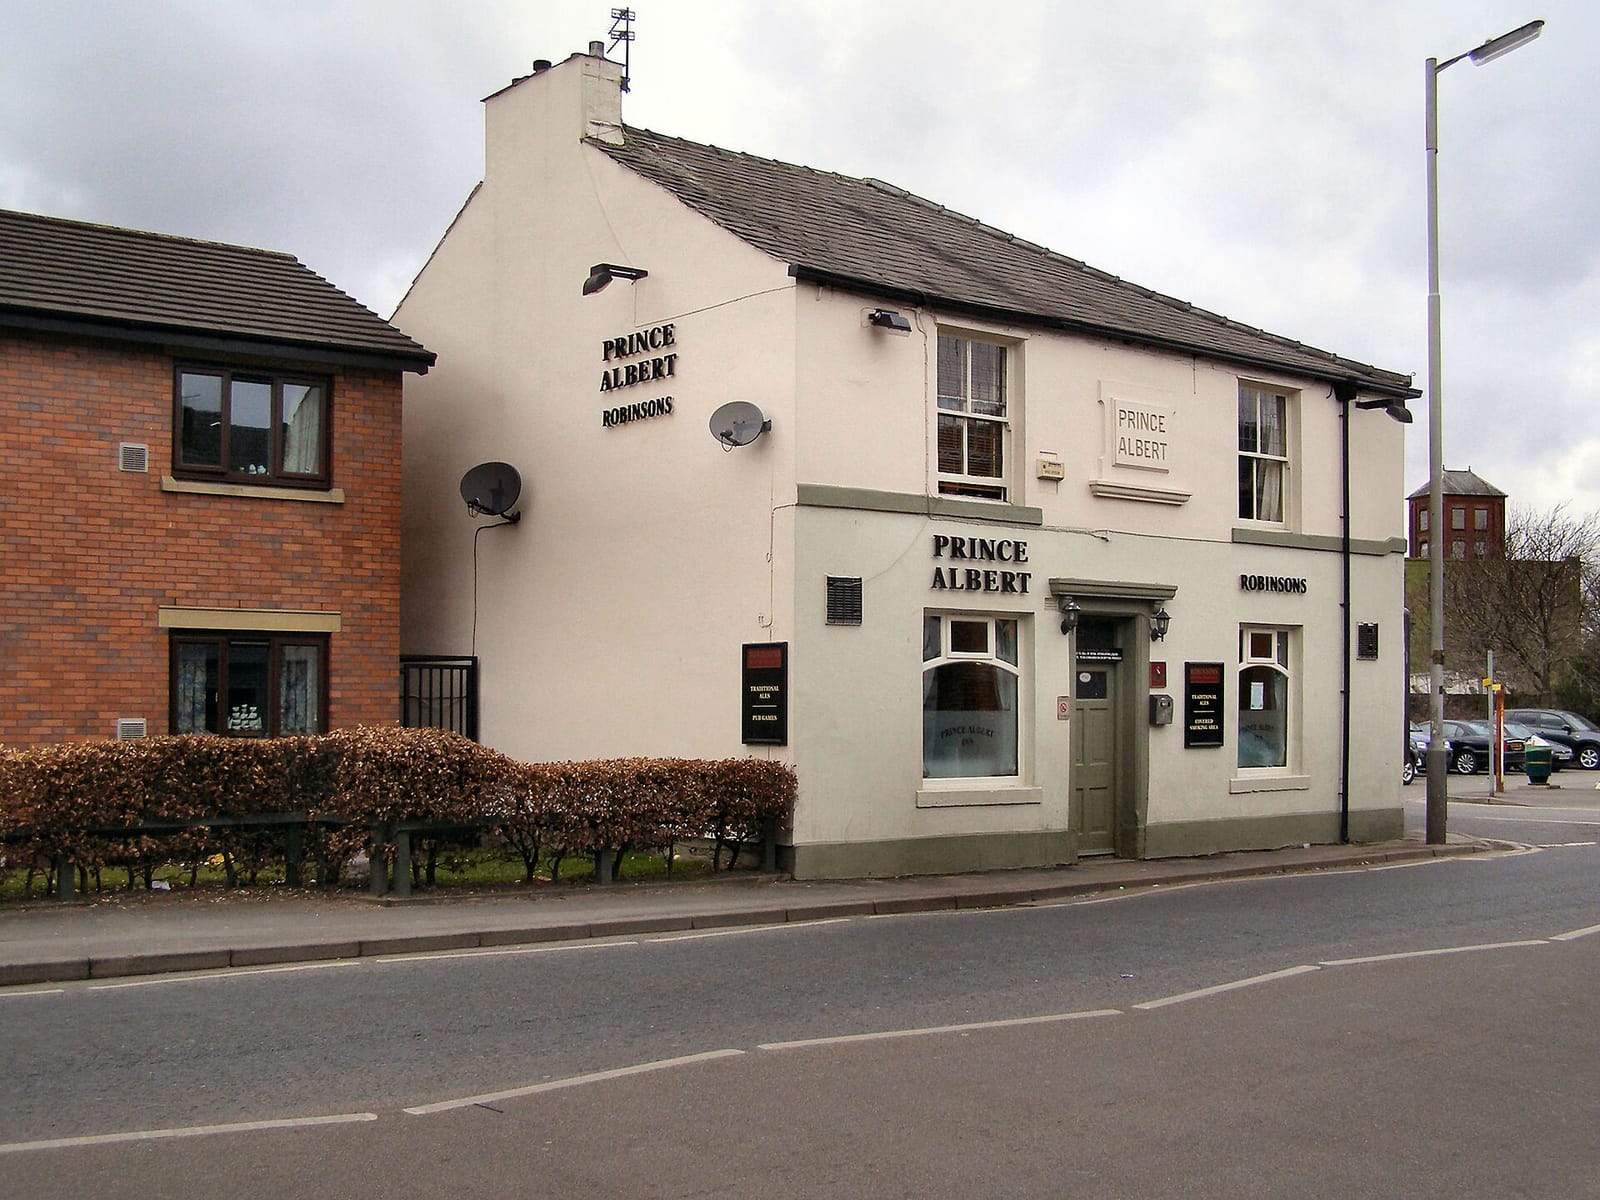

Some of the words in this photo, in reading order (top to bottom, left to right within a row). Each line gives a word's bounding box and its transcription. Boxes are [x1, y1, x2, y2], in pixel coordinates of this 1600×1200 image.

[602, 323, 676, 361] PRINCE
[600, 353, 678, 391] ALBERT
[602, 396, 673, 427] ROBINSONS
[1118, 409, 1166, 433] PRINCE
[1118, 436, 1168, 460] ALBERT
[933, 534, 1029, 562] PRINCE
[931, 566, 1032, 594] ALBERT
[1240, 574, 1307, 594] ROBINSONS
